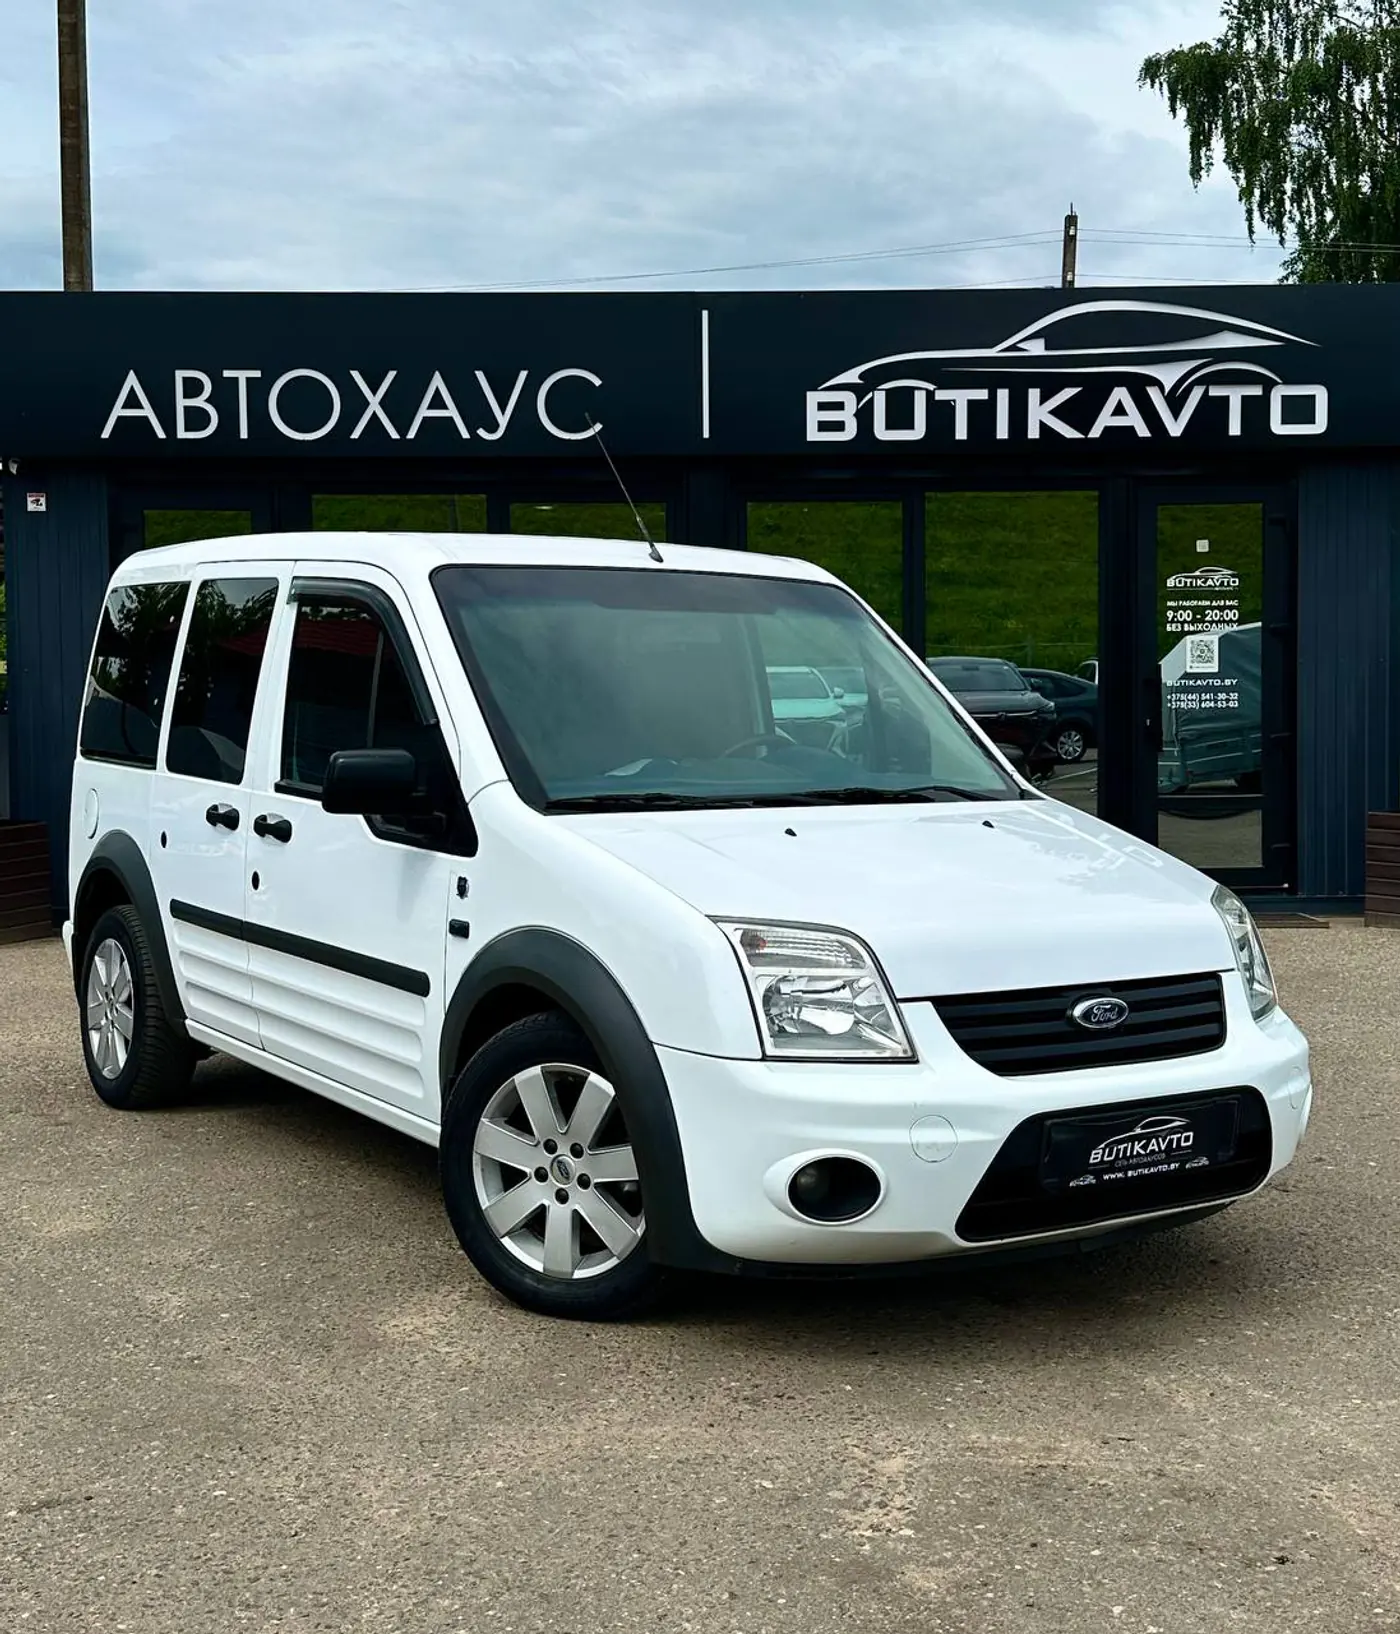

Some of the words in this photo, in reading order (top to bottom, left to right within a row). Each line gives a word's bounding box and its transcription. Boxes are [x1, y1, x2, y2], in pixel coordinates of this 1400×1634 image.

[100, 368, 603, 441] АВТОХАУС
[805, 384, 1329, 442] BUTIKAVTO
[1166, 578, 1239, 587] BUTIKAVTO
[1166, 609, 1193, 621] 9:00
[1205, 609, 1239, 621] 20:00
[1166, 623, 1182, 631] БЕЗ
[1184, 622, 1238, 631] ВЫХОДНЫХ
[1091, 1004, 1118, 1022] Ford
[1089, 1131, 1194, 1164] BUTIKAVTO
